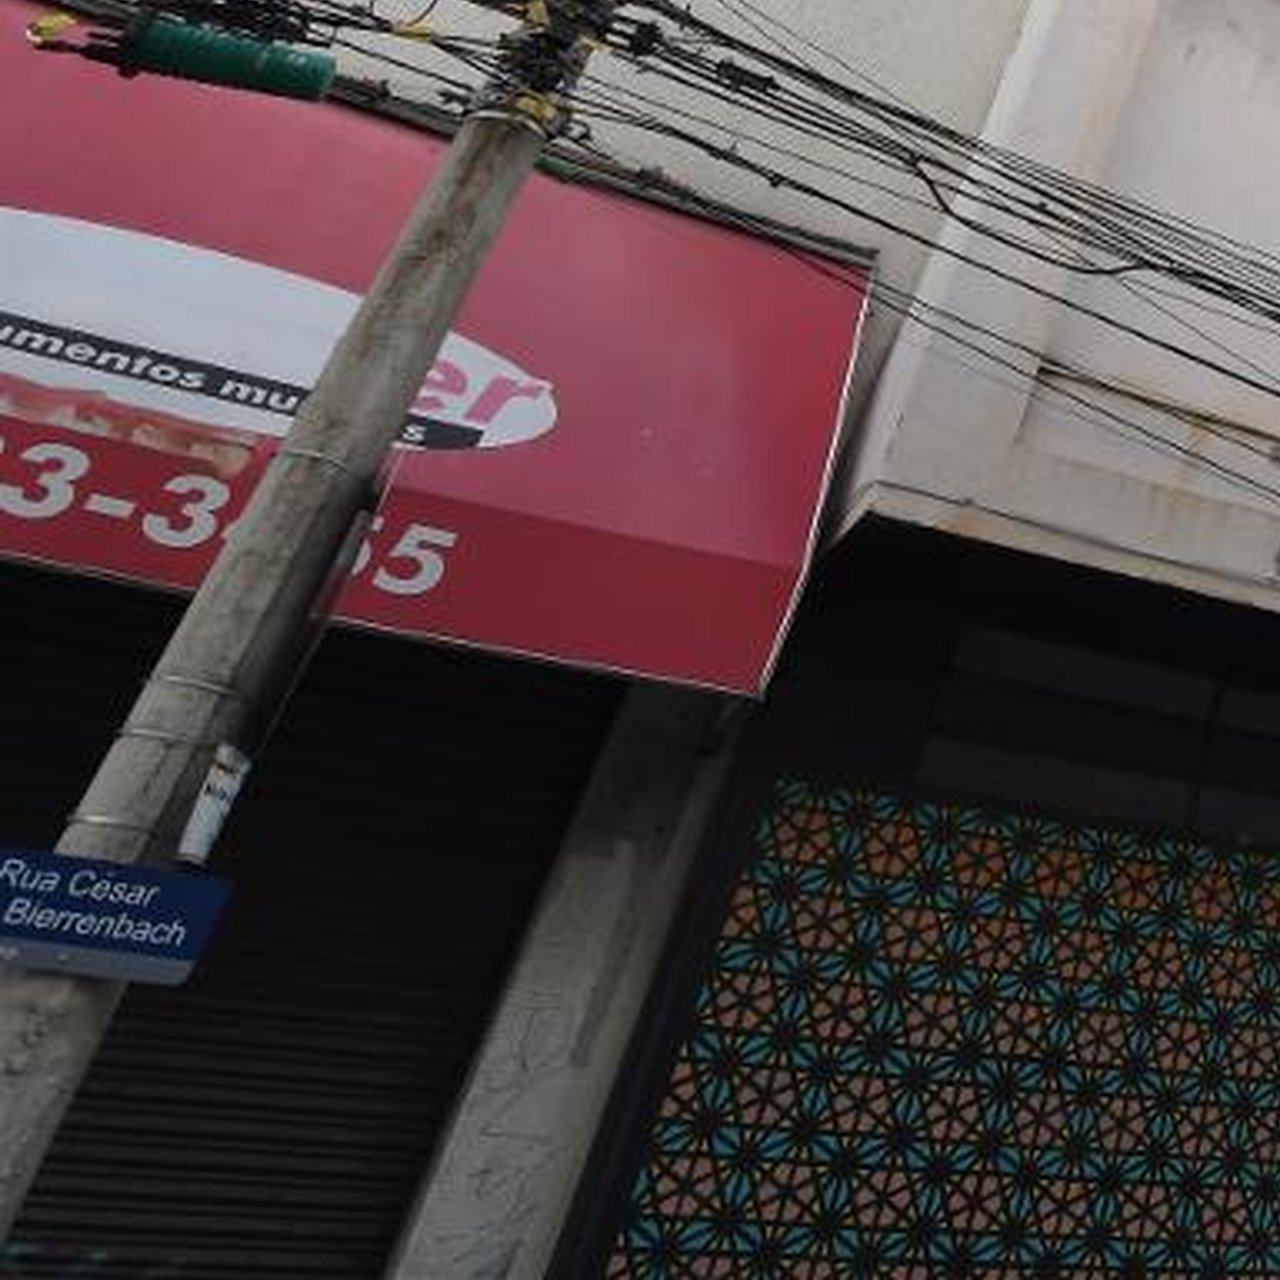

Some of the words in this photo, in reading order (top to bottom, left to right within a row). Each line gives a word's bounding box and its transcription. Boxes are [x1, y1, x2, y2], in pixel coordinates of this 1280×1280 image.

[416, 360, 541, 424] er
[0, 858, 61, 892] Rua
[3, 897, 187, 946] Bierrenbach
